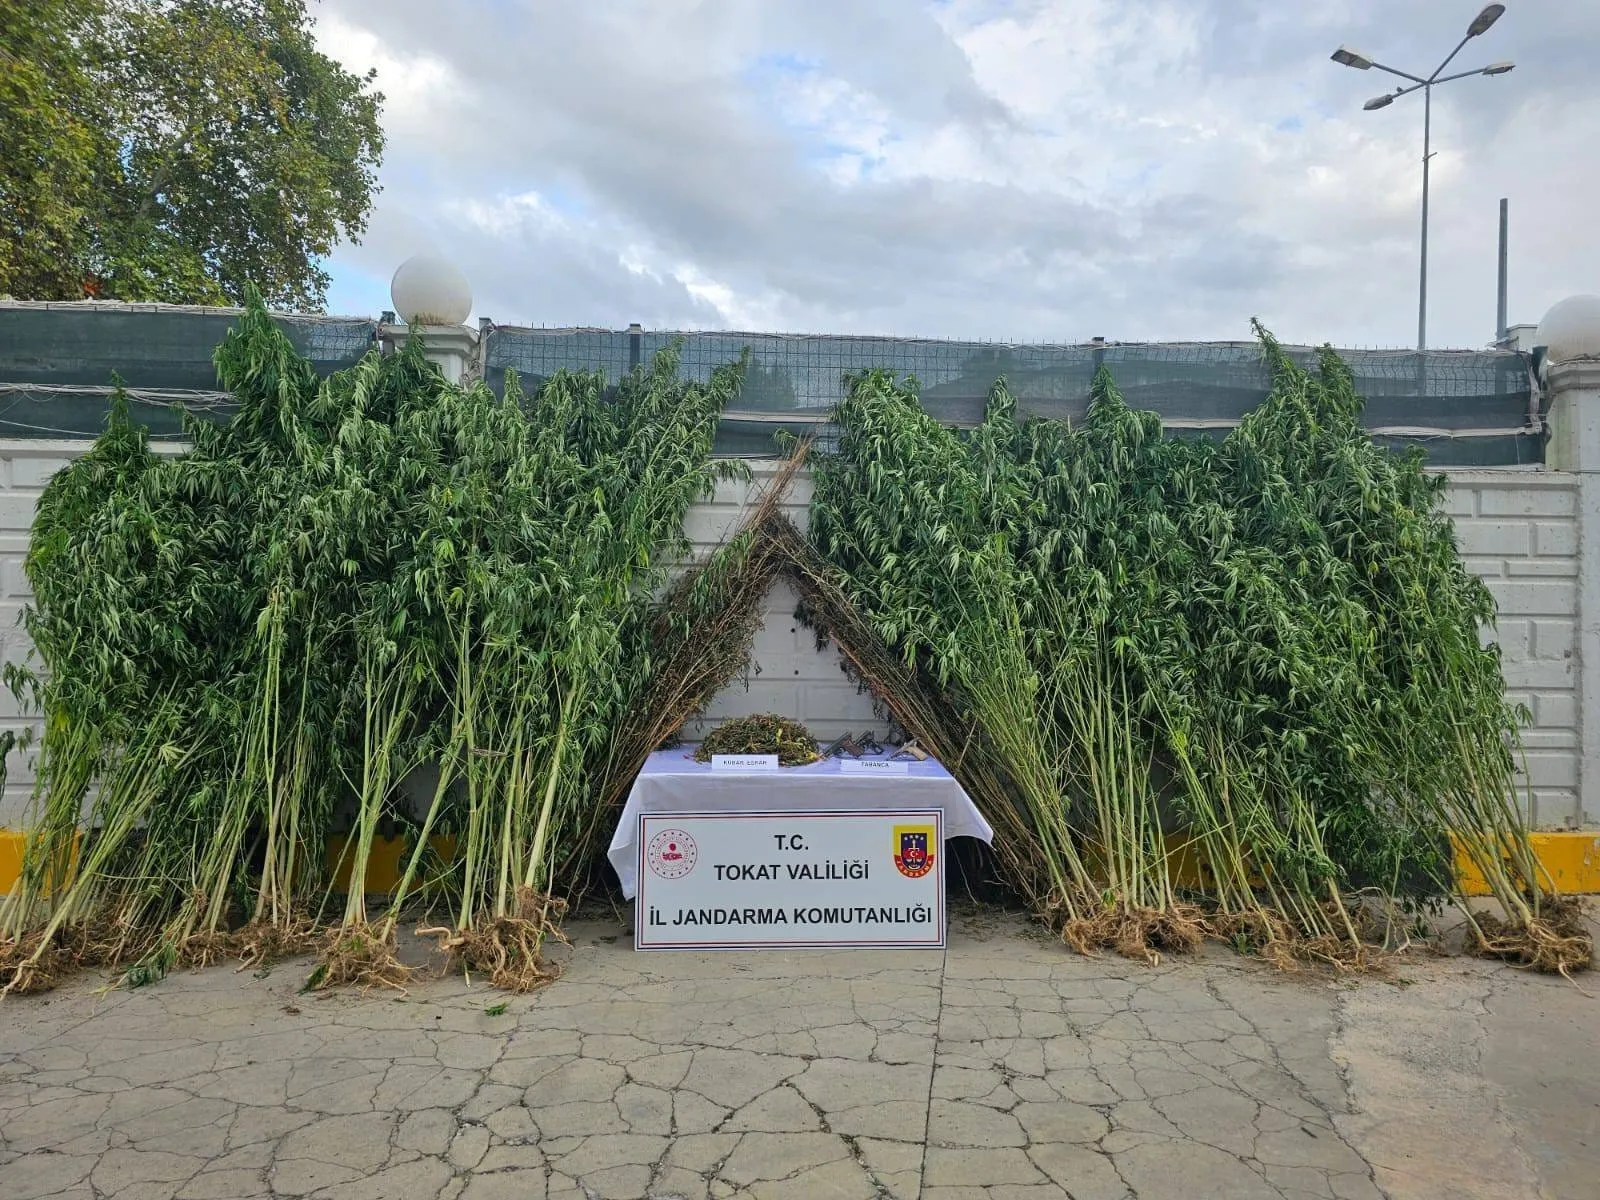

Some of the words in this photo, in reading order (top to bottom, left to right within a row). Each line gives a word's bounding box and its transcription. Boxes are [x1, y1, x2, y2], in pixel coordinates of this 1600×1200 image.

[774, 834, 809, 851] T.C.
[714, 864, 781, 881] TOKAT
[787, 859, 869, 880] VALİLİĞİ
[649, 905, 667, 926] İL
[672, 908, 787, 926] JANDARMA
[794, 903, 931, 924] KOMUTANLIĞI
